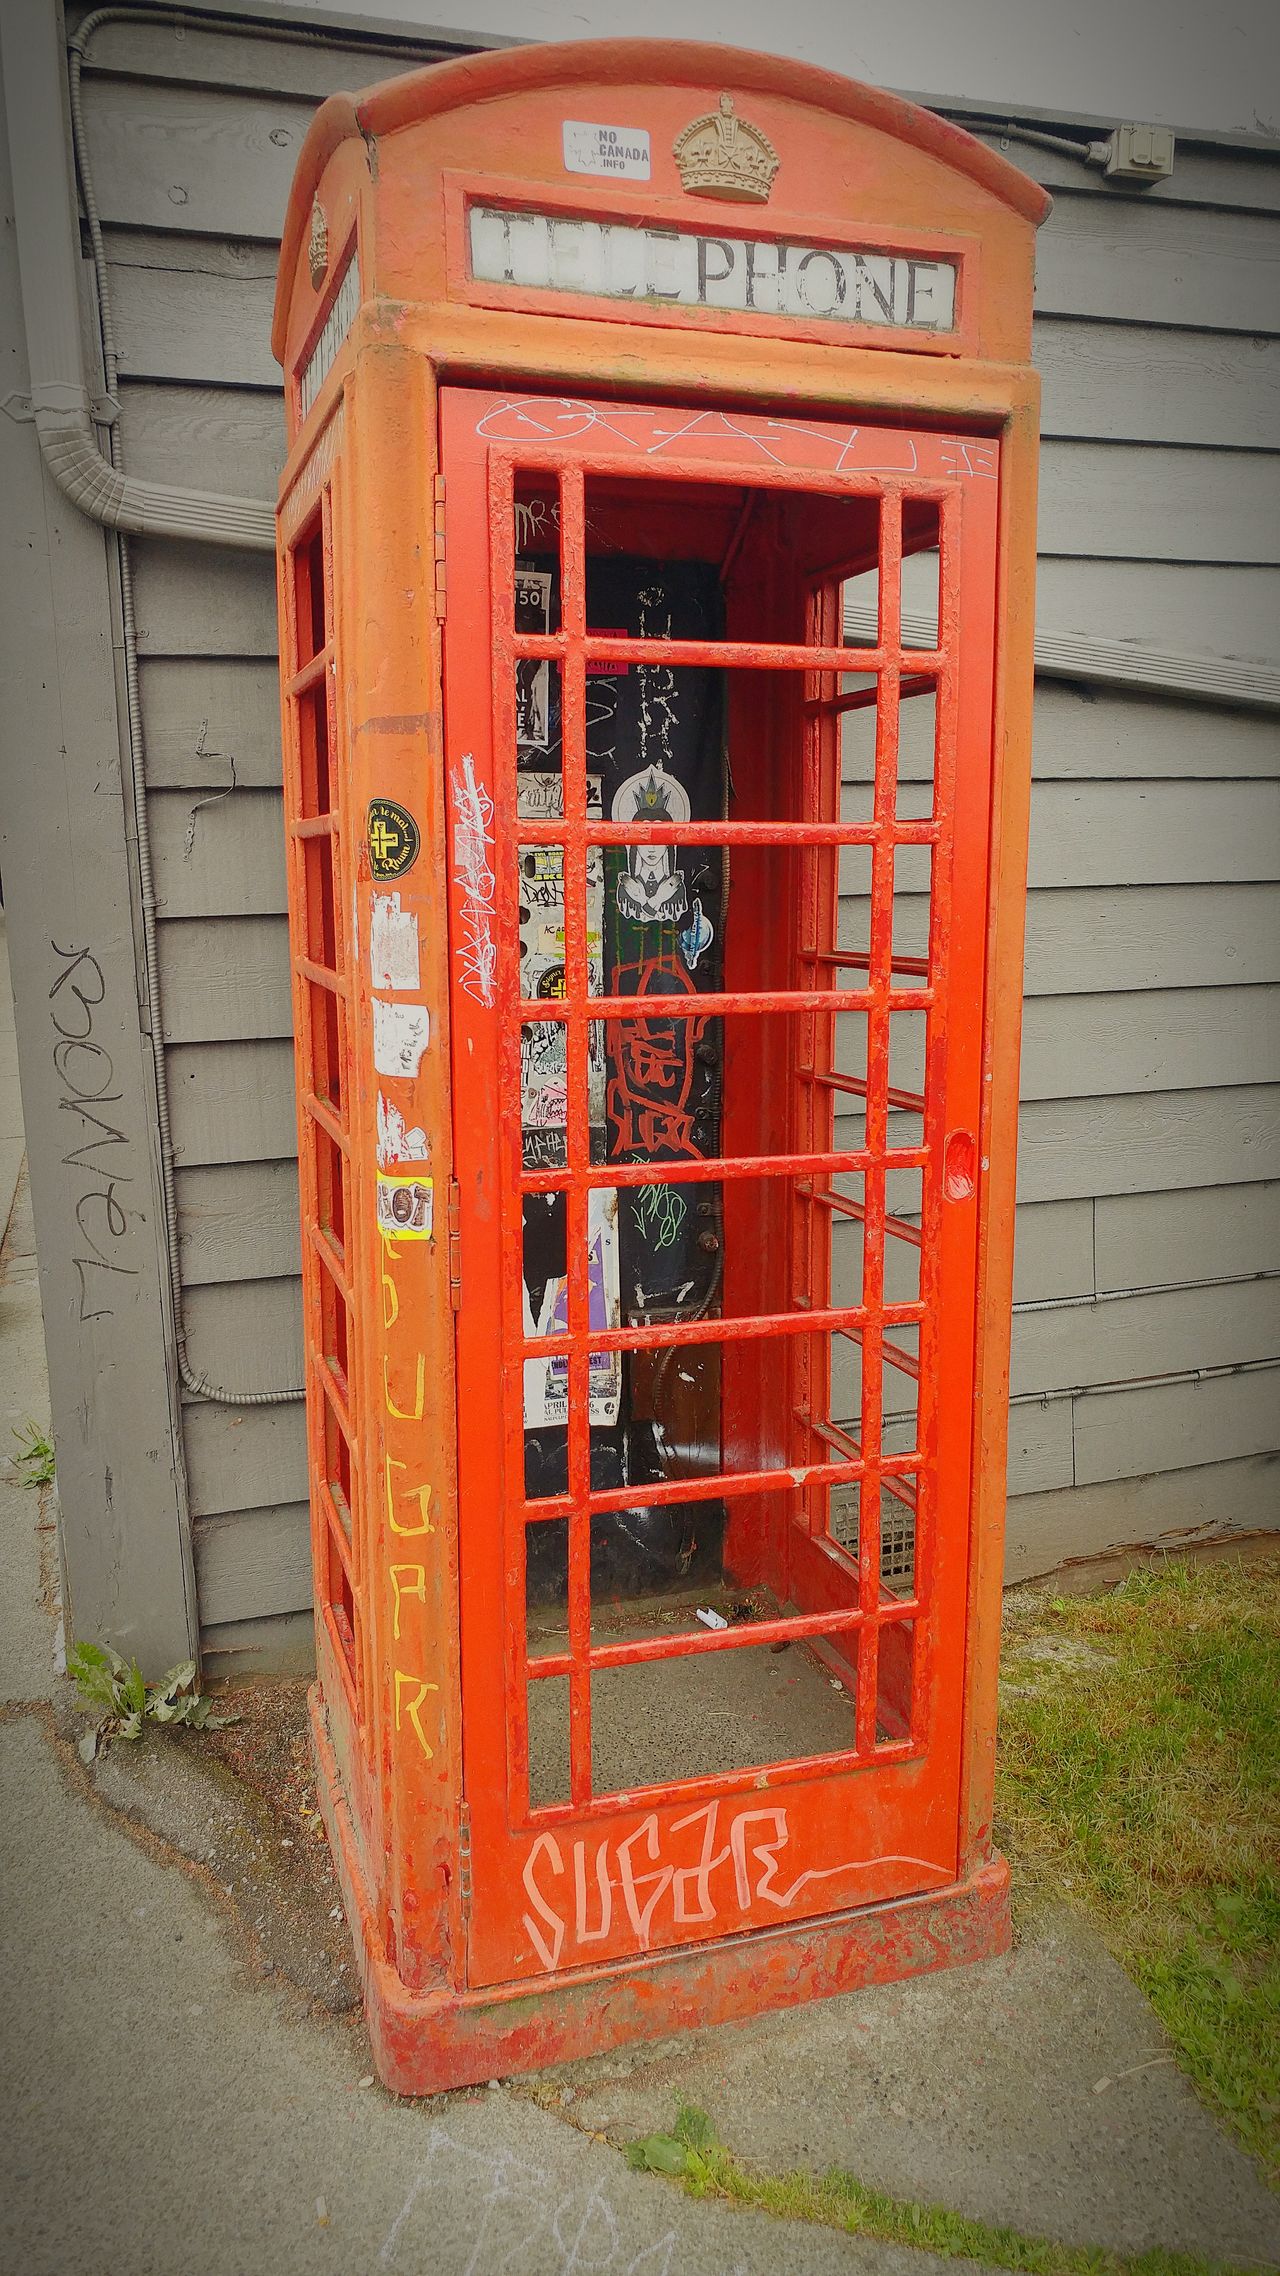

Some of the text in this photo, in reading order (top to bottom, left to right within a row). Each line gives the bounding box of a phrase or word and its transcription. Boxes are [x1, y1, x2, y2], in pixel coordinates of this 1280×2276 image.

[599, 130, 617, 144] NO
[600, 144, 648, 162] CANADA
[600, 159, 625, 170] .INFO
[381, 843, 411, 871] Rhum
